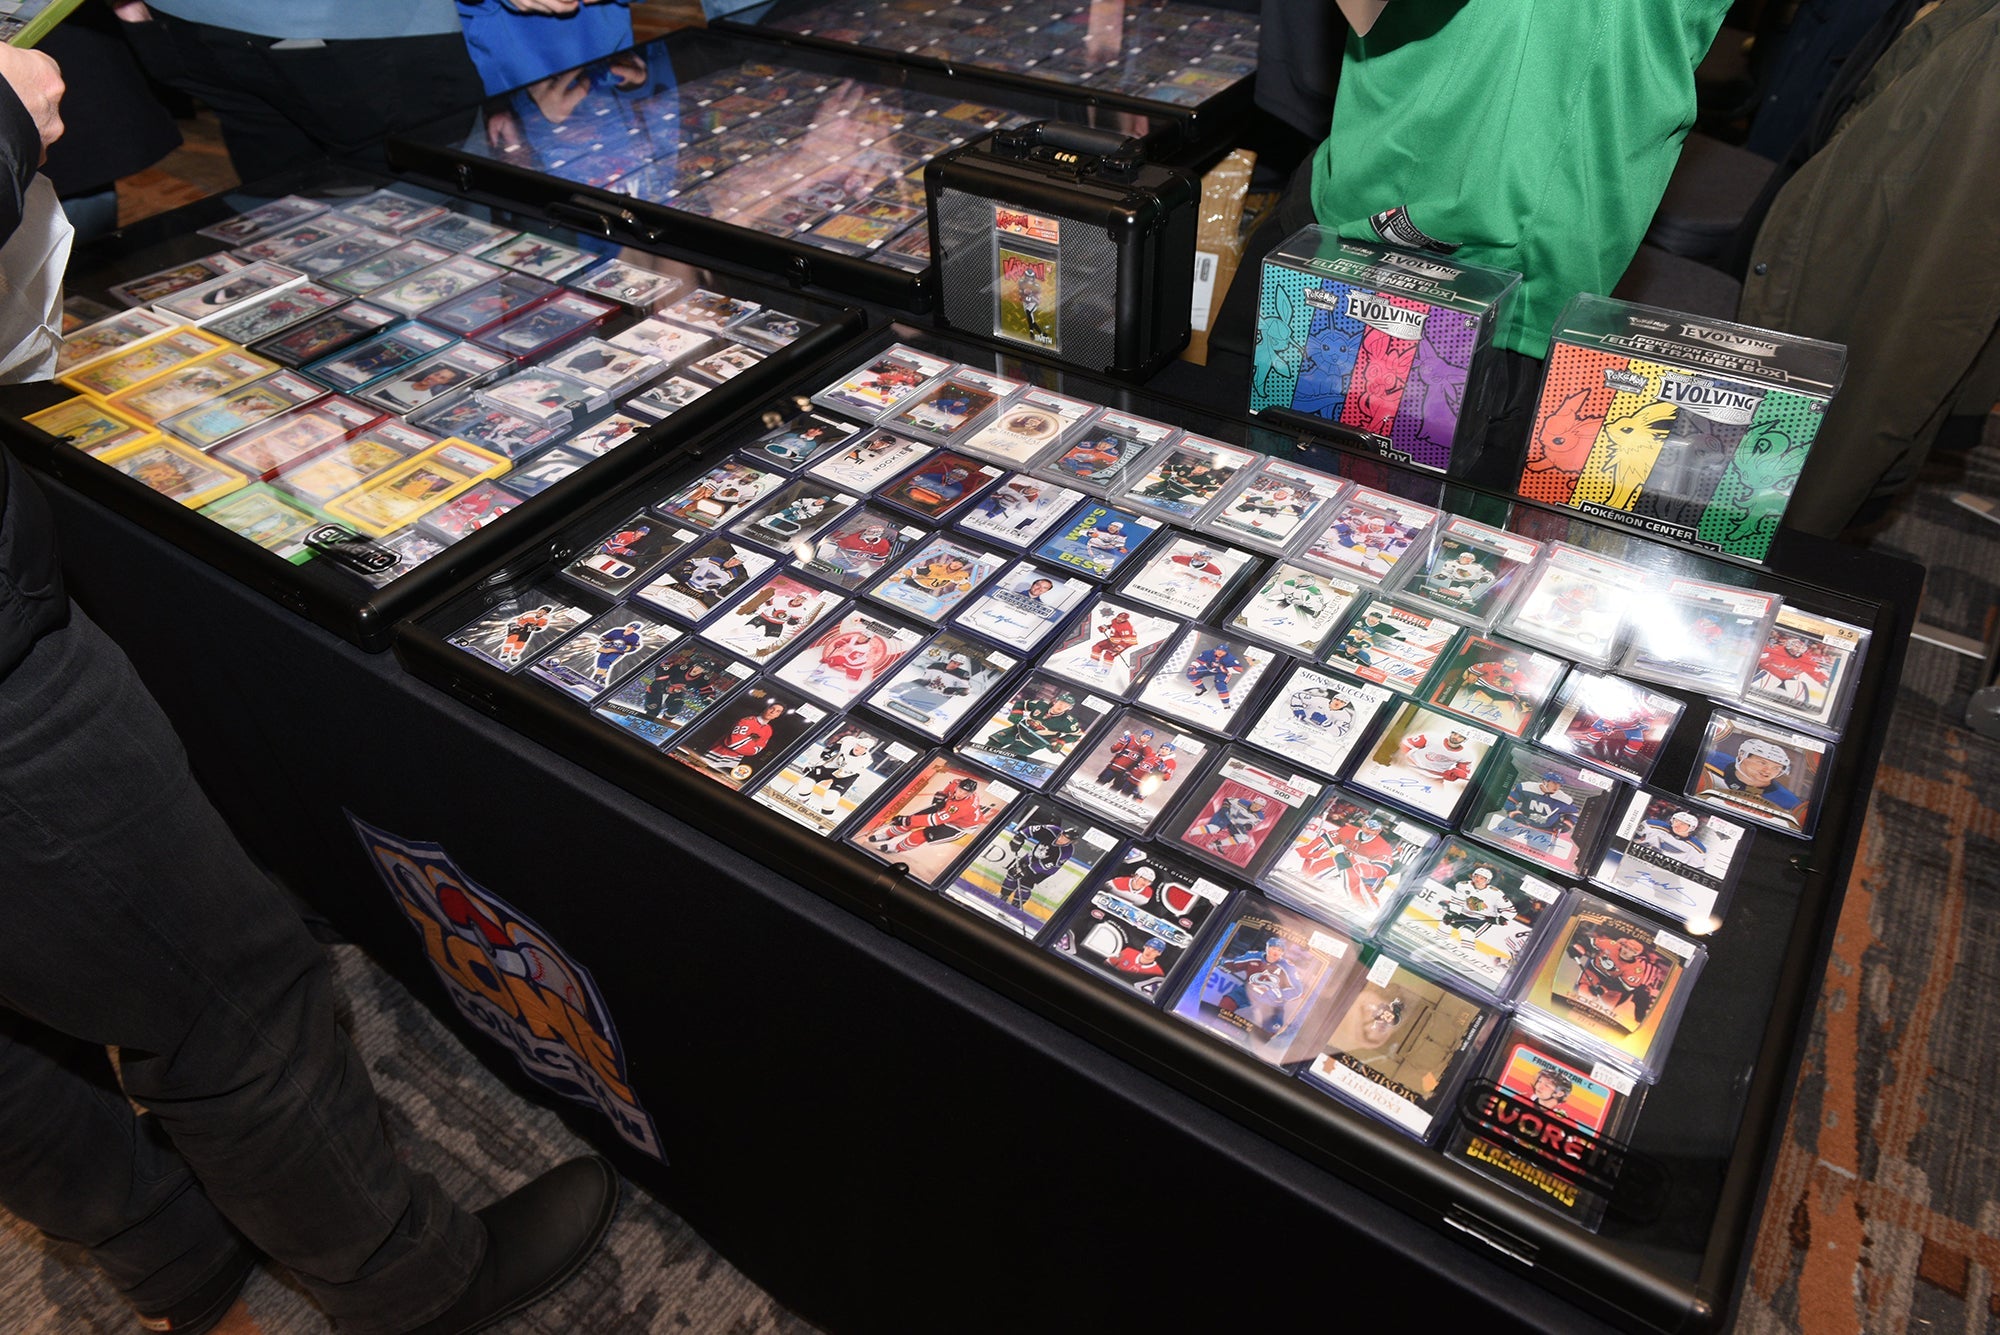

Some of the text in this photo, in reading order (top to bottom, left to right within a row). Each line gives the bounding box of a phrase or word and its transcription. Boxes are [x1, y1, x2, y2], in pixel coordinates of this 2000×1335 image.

[1385, 254, 1458, 277] EVOLVING
[1312, 260, 1349, 274] ELITE
[1417, 285, 1451, 299] BOX
[1391, 272, 1436, 288] CENTER
[1349, 299, 1422, 326] EVOLVING
[1684, 326, 1775, 351] EVOLVING
[1608, 336, 1783, 379] ELITE TRAINER BOX
[1638, 335, 1756, 367] POKÉMON CENTER
[1661, 380, 1755, 409] EVOLVING
[1810, 403, 1822, 412] 6+
[1583, 505, 1693, 540] POKÉMON CENTER
[1394, 611, 1428, 626] CLASSIC
[1838, 629, 1854, 639] 9.5
[1302, 671, 1328, 686] SIGNS
[1335, 683, 1377, 704] SUCCESS
[732, 725, 749, 735] 22
[770, 791, 798, 809] YOUNG
[1273, 789, 1290, 800] 500
[1383, 784, 1405, 796] VELENO
[938, 810, 950, 820] 19
[1529, 800, 1560, 818] NY
[1147, 859, 1169, 871] BLACK
[1633, 843, 1682, 867] ULTIMATE
[1628, 848, 1717, 889] SIGNATURES
[1099, 897, 1184, 943] DUAL RELICS
[1608, 919, 1655, 944] STATURE
[1219, 1008, 1233, 1018] Cale
[1234, 1014, 1254, 1028] Makar
[1340, 1055, 1419, 1103] MOMENTS
[1466, 1137, 1581, 1208] BLACKHAWKS
